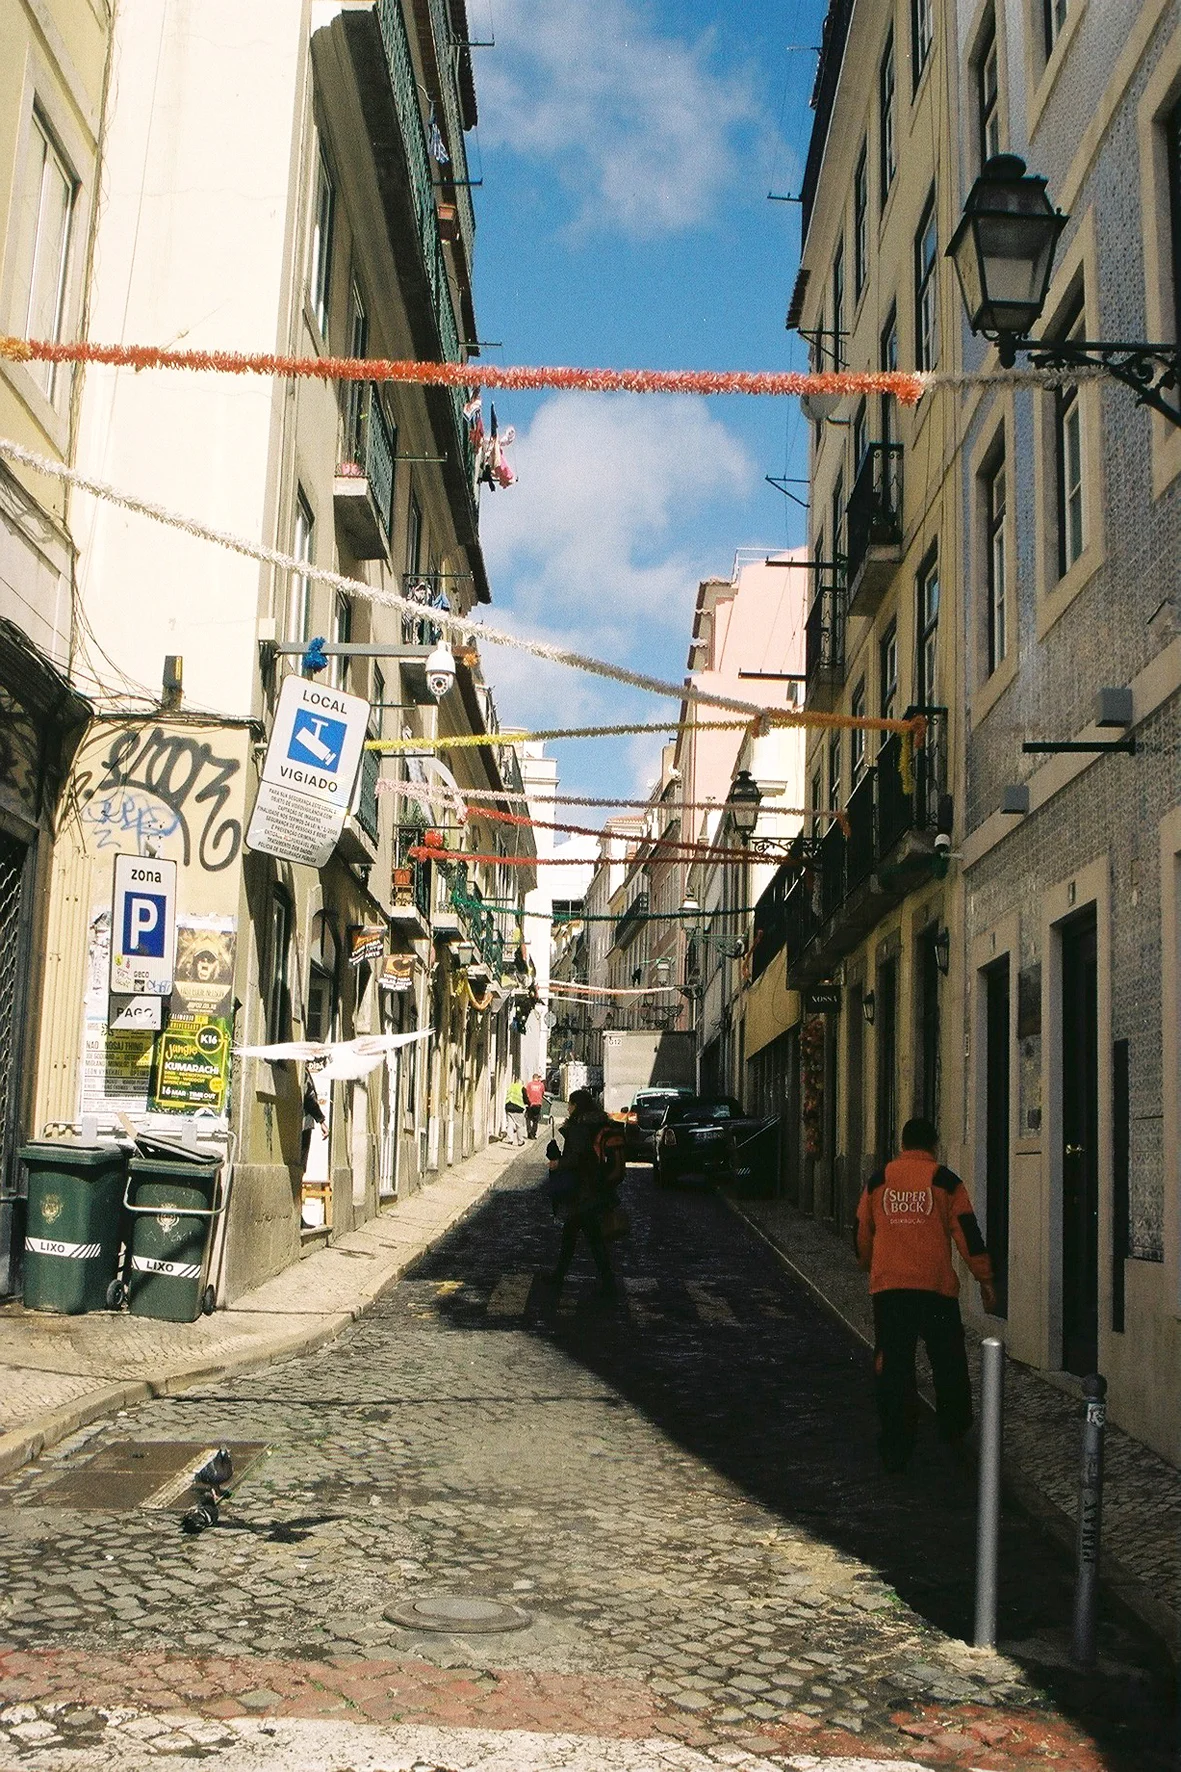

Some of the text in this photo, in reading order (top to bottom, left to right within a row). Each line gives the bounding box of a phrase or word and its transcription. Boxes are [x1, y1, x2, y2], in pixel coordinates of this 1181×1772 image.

[303, 690, 348, 715] LOCAL
[280, 766, 338, 793] VIGIADO
[131, 868, 162, 883] zona
[130, 898, 158, 950] P
[199, 1034, 217, 1044] K16
[164, 1061, 219, 1074] KUMARACHI
[162, 1085, 171, 1094] 16
[889, 1190, 926, 1202] SUPER
[891, 1202, 924, 1212] BOCK
[40, 1241, 65, 1254] LIXO
[146, 1260, 174, 1273] LIXO
